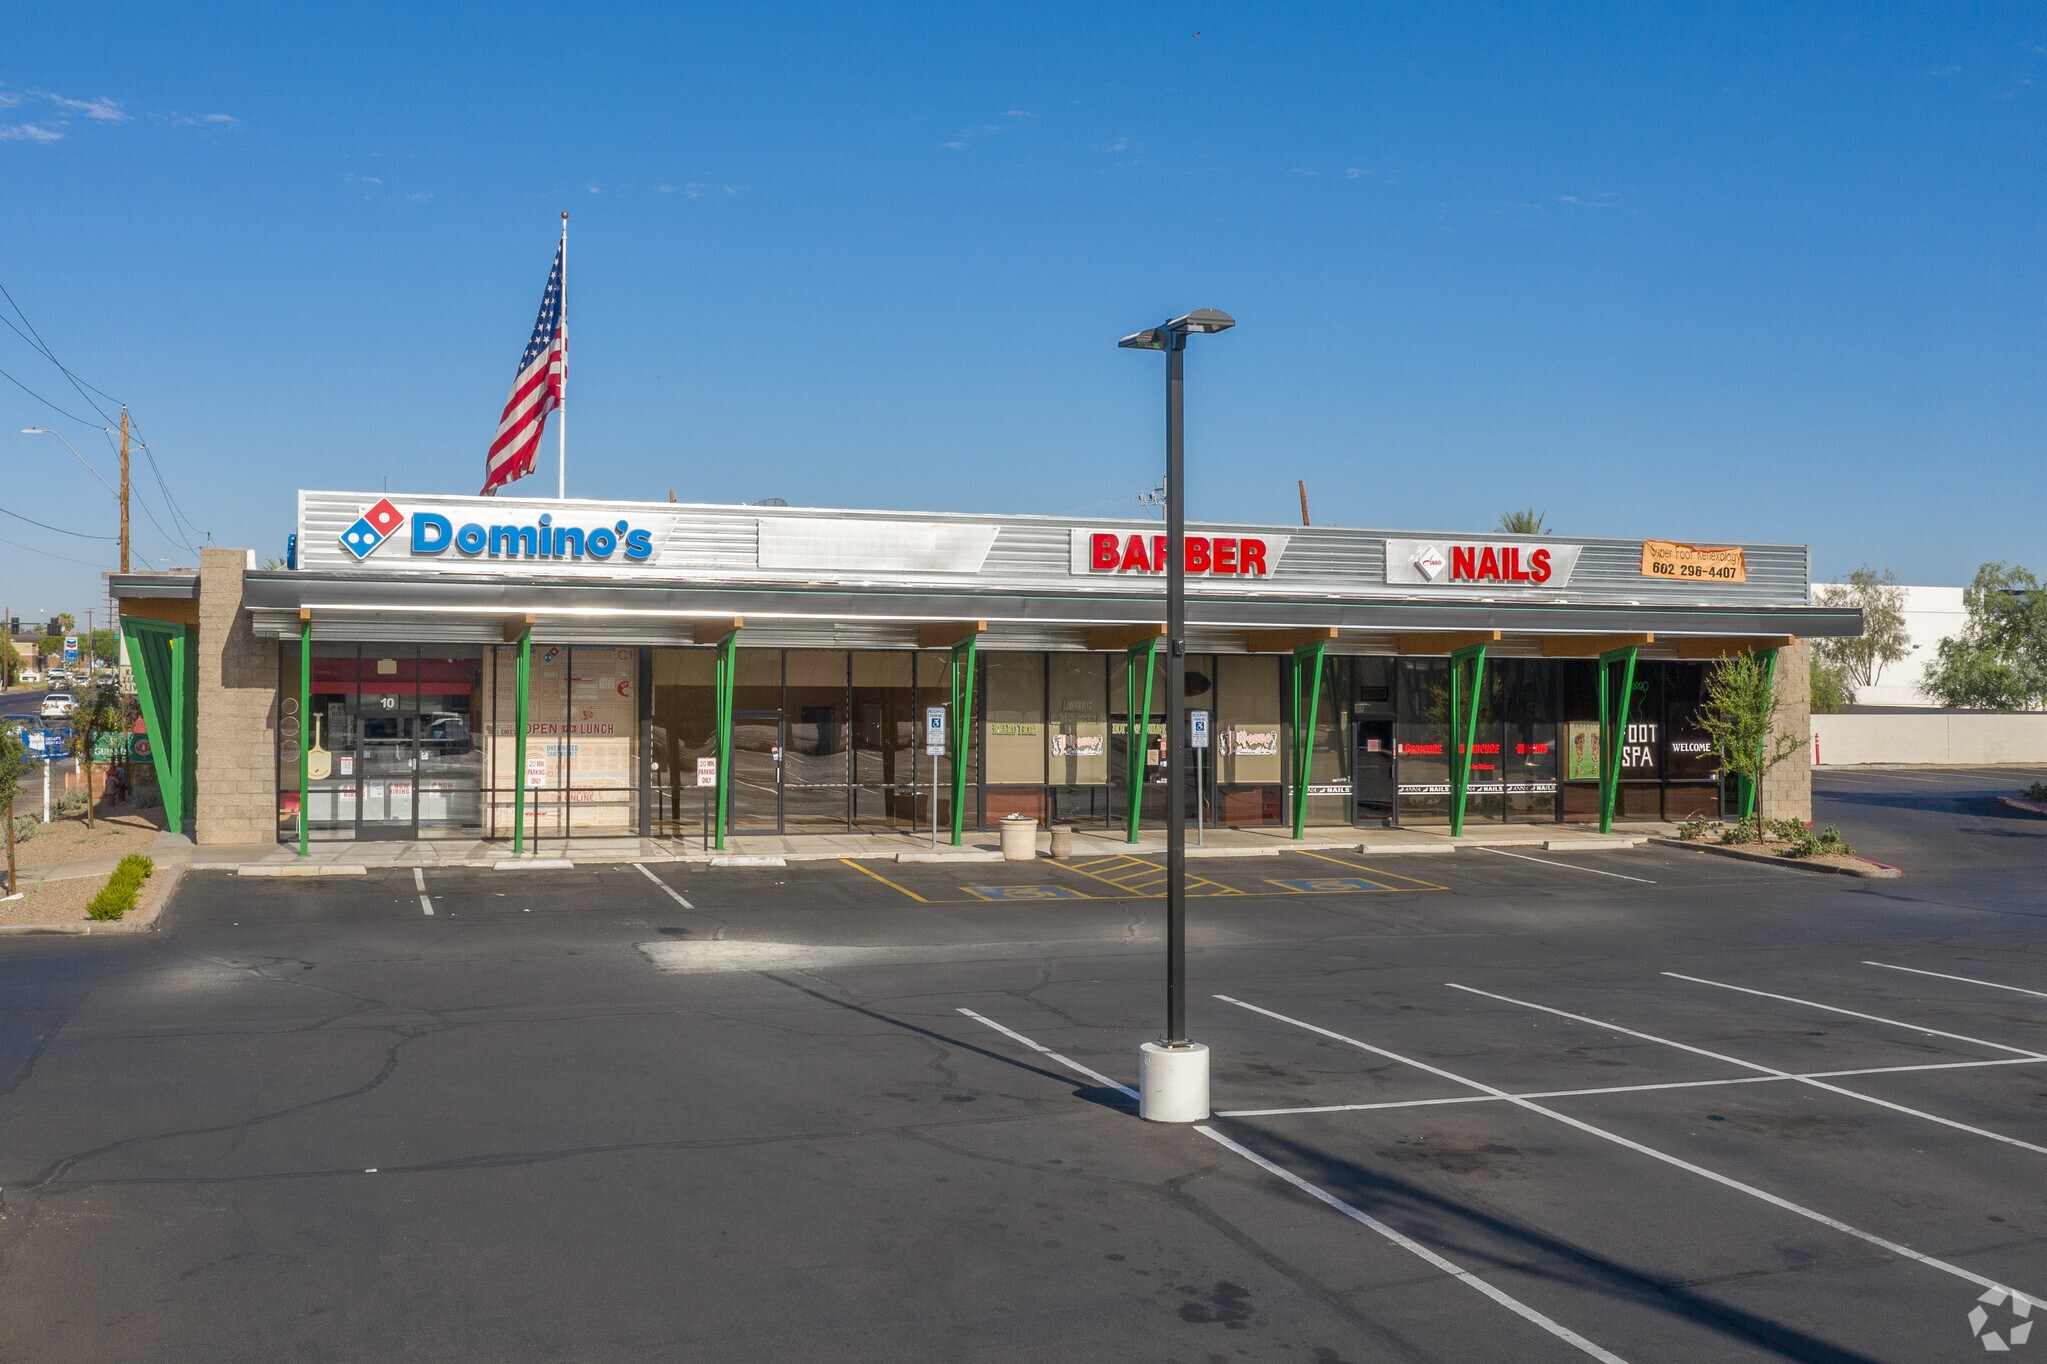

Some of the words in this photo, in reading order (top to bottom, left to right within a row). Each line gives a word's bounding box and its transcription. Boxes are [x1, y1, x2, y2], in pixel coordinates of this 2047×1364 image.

[411, 511, 653, 559] Domino's
[1091, 533, 1267, 575] BARBER
[1650, 544, 1672, 560] Super
[1422, 555, 1442, 567] Anna
[1451, 545, 1552, 583] NAILS
[1652, 562, 1675, 575] 602
[380, 697, 395, 709] 10
[525, 723, 558, 734] OPEN
[580, 723, 614, 734] LUNCH
[1623, 724, 1657, 743] OOT
[1672, 743, 1711, 752] WELCOME
[1621, 746, 1653, 767] SPA
[388, 788, 410, 796] HIRING
